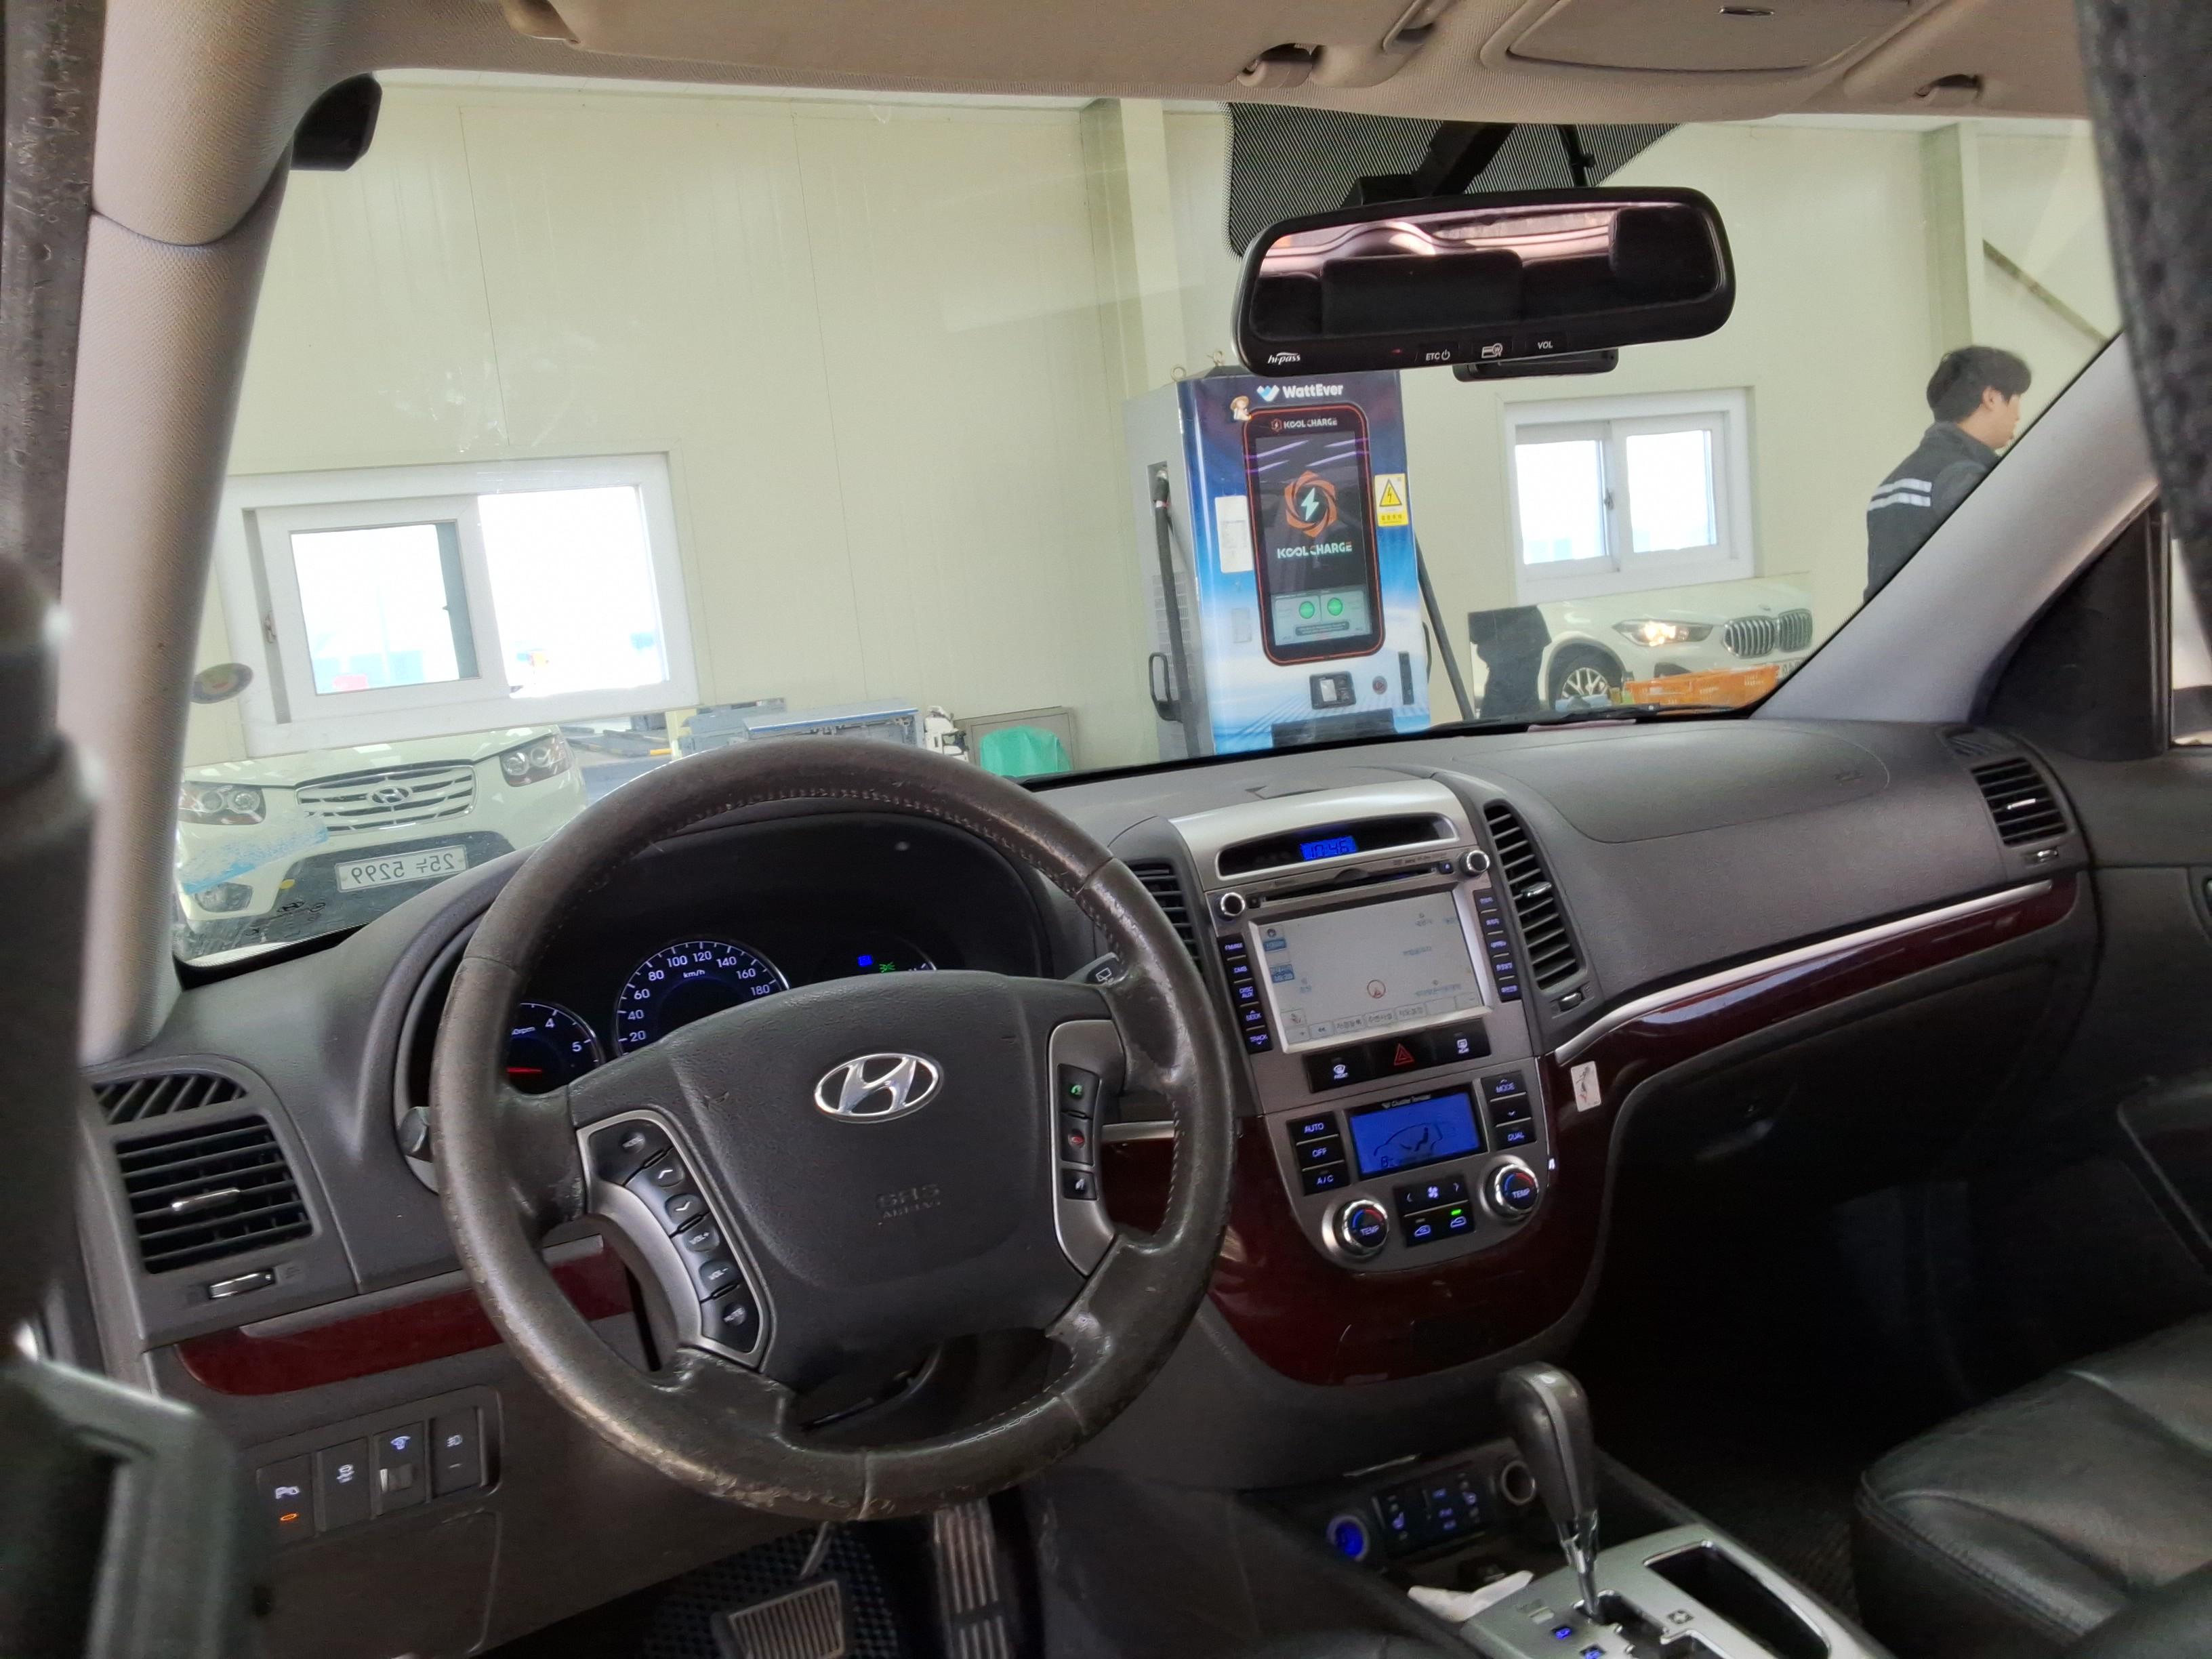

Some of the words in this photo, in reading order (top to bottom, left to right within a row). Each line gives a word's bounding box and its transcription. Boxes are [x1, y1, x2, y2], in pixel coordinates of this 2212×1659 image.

[1537, 341, 1553, 350] VOL
[1425, 352, 1441, 361] ETC
[1282, 384, 1343, 398] WattEver
[1284, 419, 1306, 429] KOOL
[1307, 417, 1338, 427] CHARGE
[1277, 546, 1309, 559] KOOL
[1309, 541, 1353, 556] CHARGE
[667, 955, 688, 968] 100
[693, 950, 712, 962] 120
[716, 956, 737, 968] 140
[648, 970, 665, 981] 80
[683, 969, 705, 979] km/h
[736, 968, 756, 980] 160
[634, 988, 651, 1000] 60
[751, 984, 771, 996] 180
[628, 1009, 644, 1020] 40
[545, 1018, 555, 1028] 4
[630, 1030, 647, 1042] 20
[572, 1042, 582, 1052] 5
[1304, 1122, 1324, 1133] AUTO
[1507, 1132, 1525, 1142] DUAL
[1312, 1147, 1327, 1158] OFF
[1317, 1174, 1334, 1186] A/C
[1512, 1187, 1530, 1199] TEMP
[1360, 1225, 1380, 1236] TEMP
